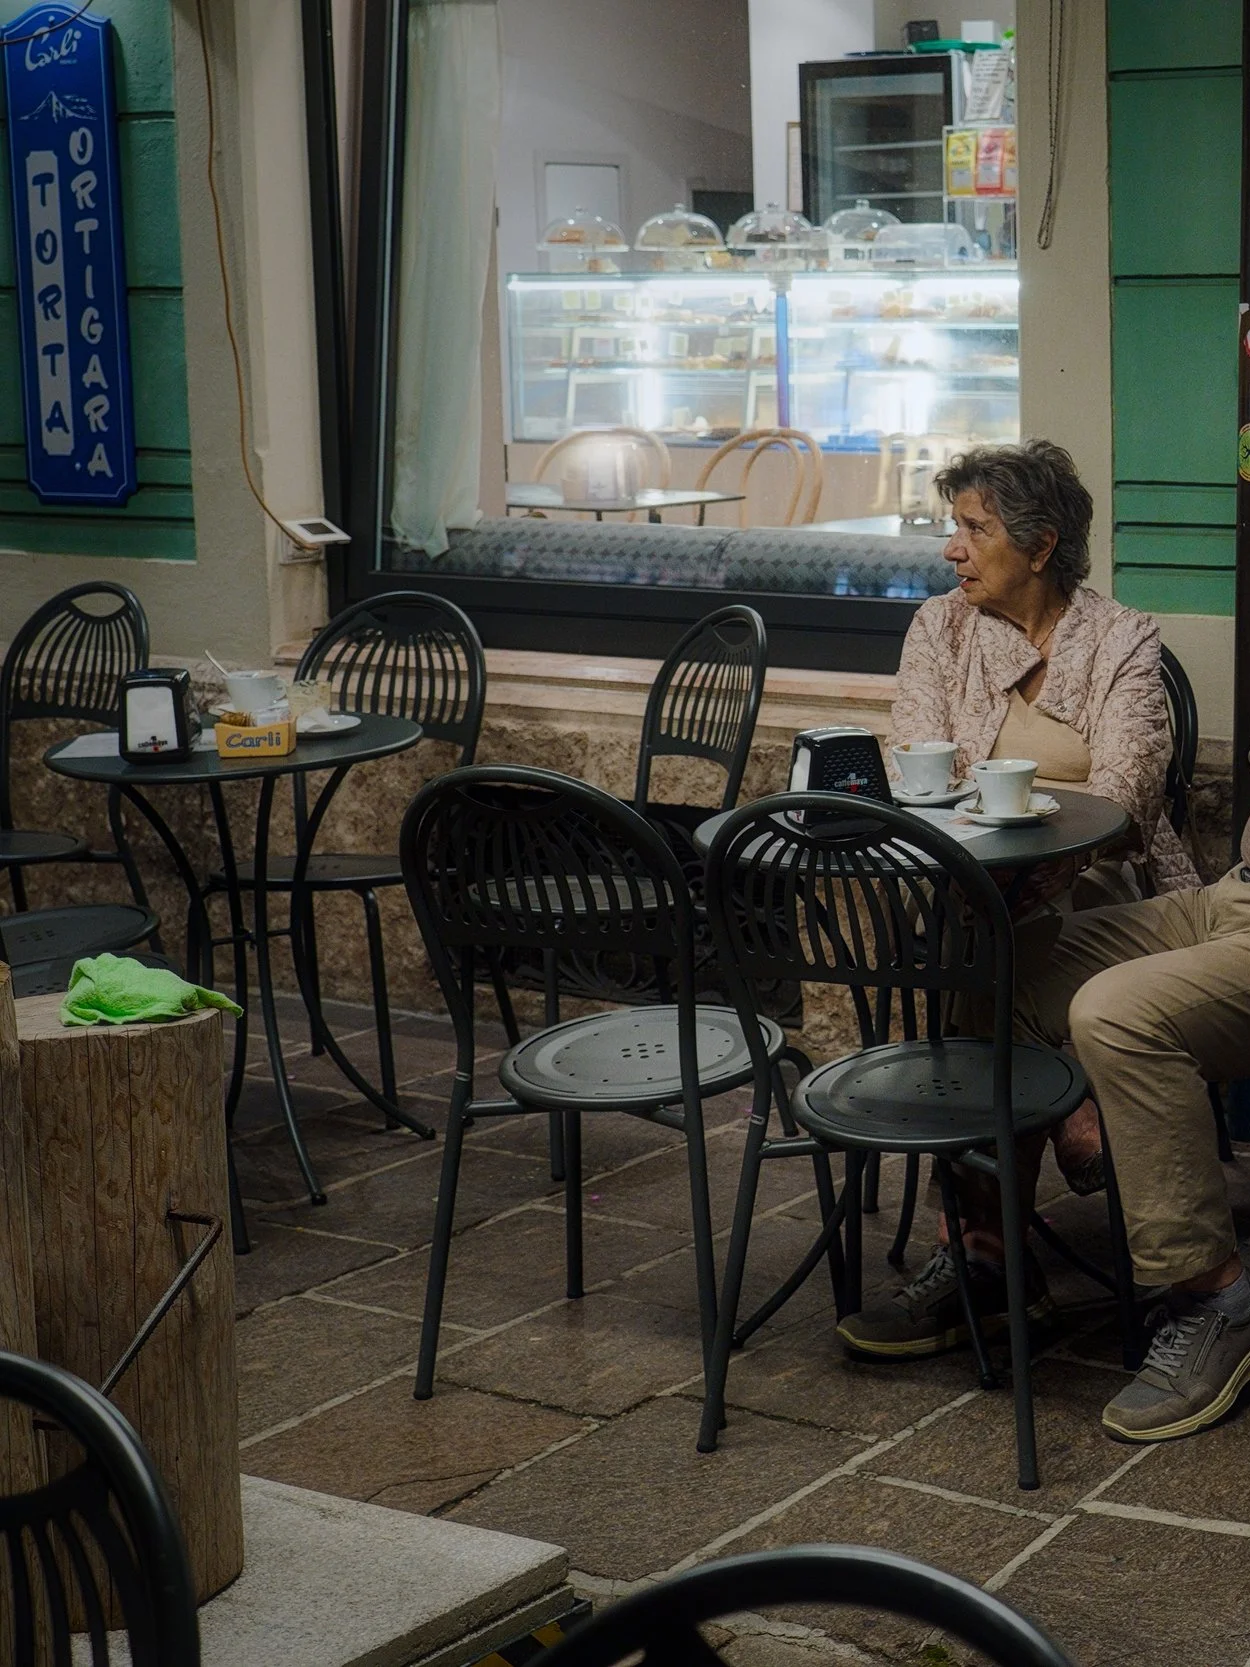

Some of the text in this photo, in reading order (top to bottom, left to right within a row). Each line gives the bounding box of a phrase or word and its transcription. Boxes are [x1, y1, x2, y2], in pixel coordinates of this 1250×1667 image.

[25, 17, 82, 71] Carli
[32, 171, 71, 435] TORTA
[69, 126, 114, 479] ORTIGARA
[225, 731, 281, 749] Carli
